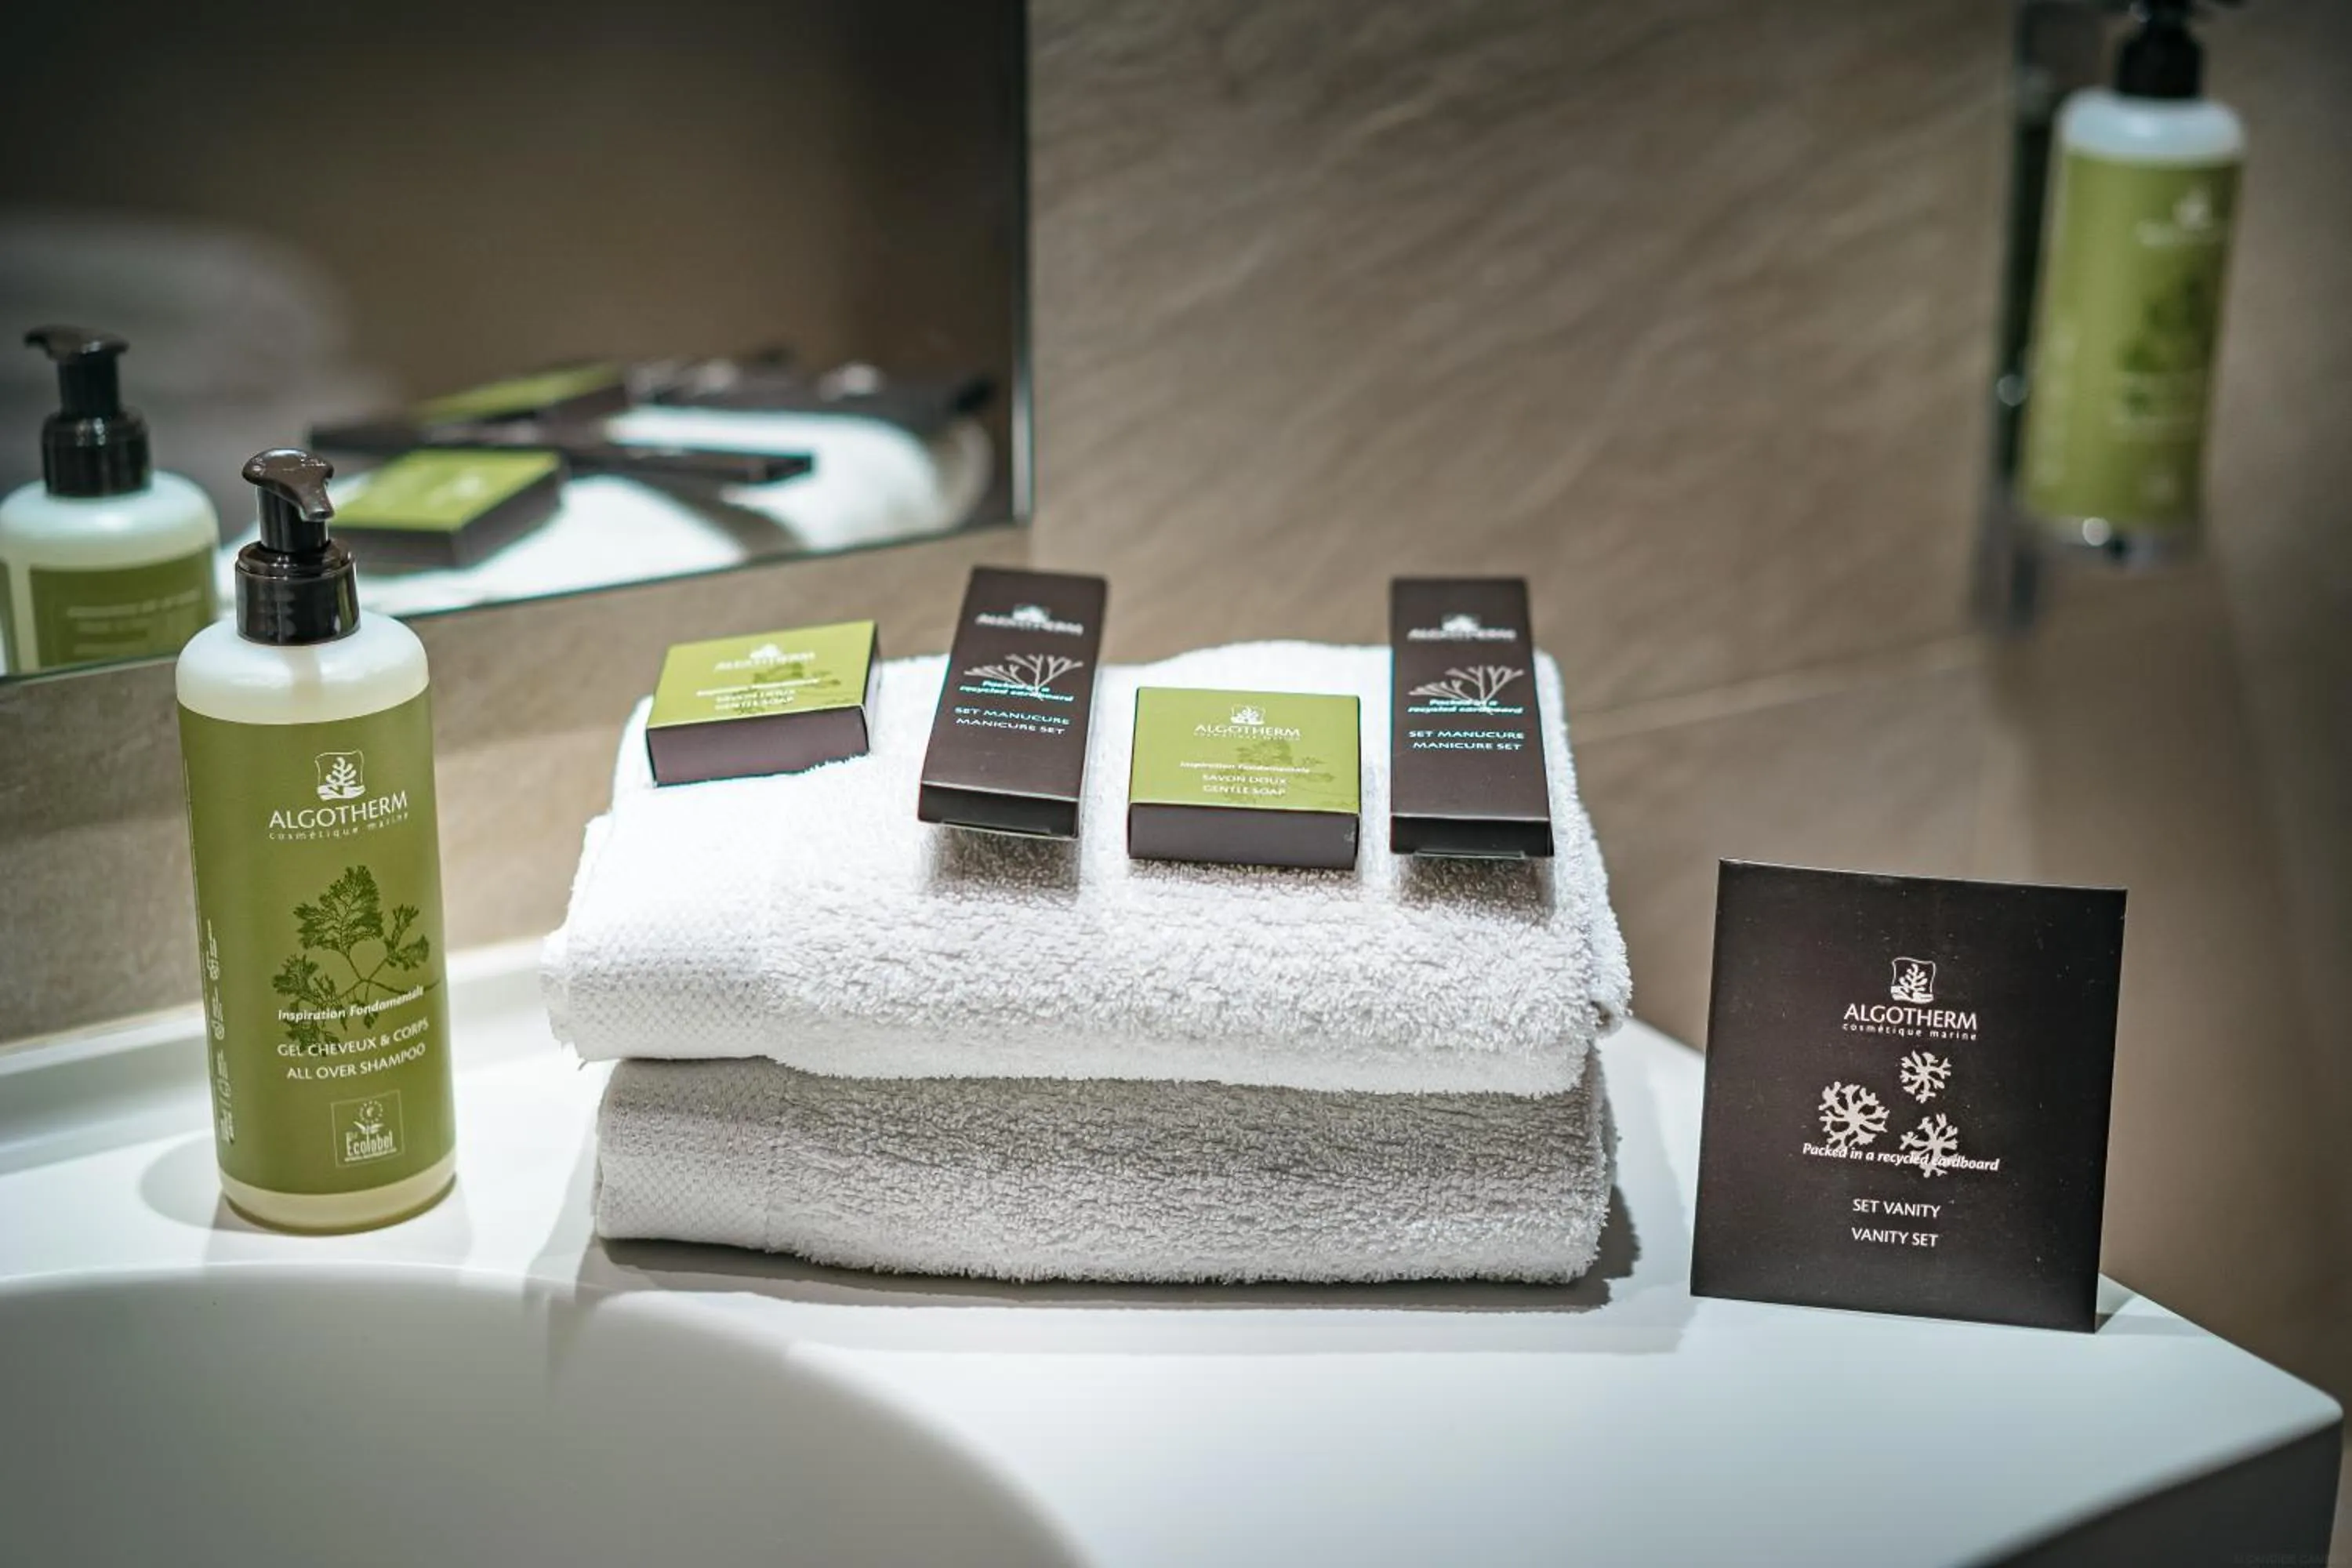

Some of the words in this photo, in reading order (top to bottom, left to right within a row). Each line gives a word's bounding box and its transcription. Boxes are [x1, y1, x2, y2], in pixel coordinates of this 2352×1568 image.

[955, 706, 982, 716] SET
[983, 710, 1070, 726] MANUCURE
[956, 717, 1036, 731] MANICURE
[1040, 726, 1065, 735] SET
[1194, 724, 1301, 737] ALGOTHERM
[1409, 730, 1433, 739] SET
[1437, 731, 1525, 740] MANUCURE
[1413, 742, 1493, 750] MANICURE
[1201, 774, 1246, 784] SAVON
[1249, 775, 1288, 785] DOUX
[1203, 785, 1248, 795] GENTLE
[1250, 786, 1287, 797] SOAP
[269, 790, 408, 829] ALGOTHERM
[278, 1008, 346, 1024] Inspiration
[1843, 1003, 1977, 1031] ALGOTHERM
[277, 1044, 303, 1057] GEL
[307, 1036, 378, 1057] CHEVEUX
[379, 1034, 390, 1047] &
[393, 1016, 429, 1042] CORPS
[1842, 1022, 1922, 1038] cosmétique
[1929, 1030, 1977, 1042] marine
[287, 1067, 313, 1080] ALL
[316, 1063, 358, 1080] OVER
[360, 1042, 426, 1075] SHAMPOO
[1802, 1142, 1848, 1159] Packed
[1849, 1147, 1864, 1160] in
[1865, 1152, 1875, 1162] a
[1877, 1150, 1929, 1167] recycled
[1930, 1155, 2000, 1171] cardboard
[1853, 1198, 1880, 1214] SET
[1883, 1200, 1942, 1219] VANITY
[1851, 1227, 1909, 1245] VANITY
[1911, 1232, 1939, 1247] SET
